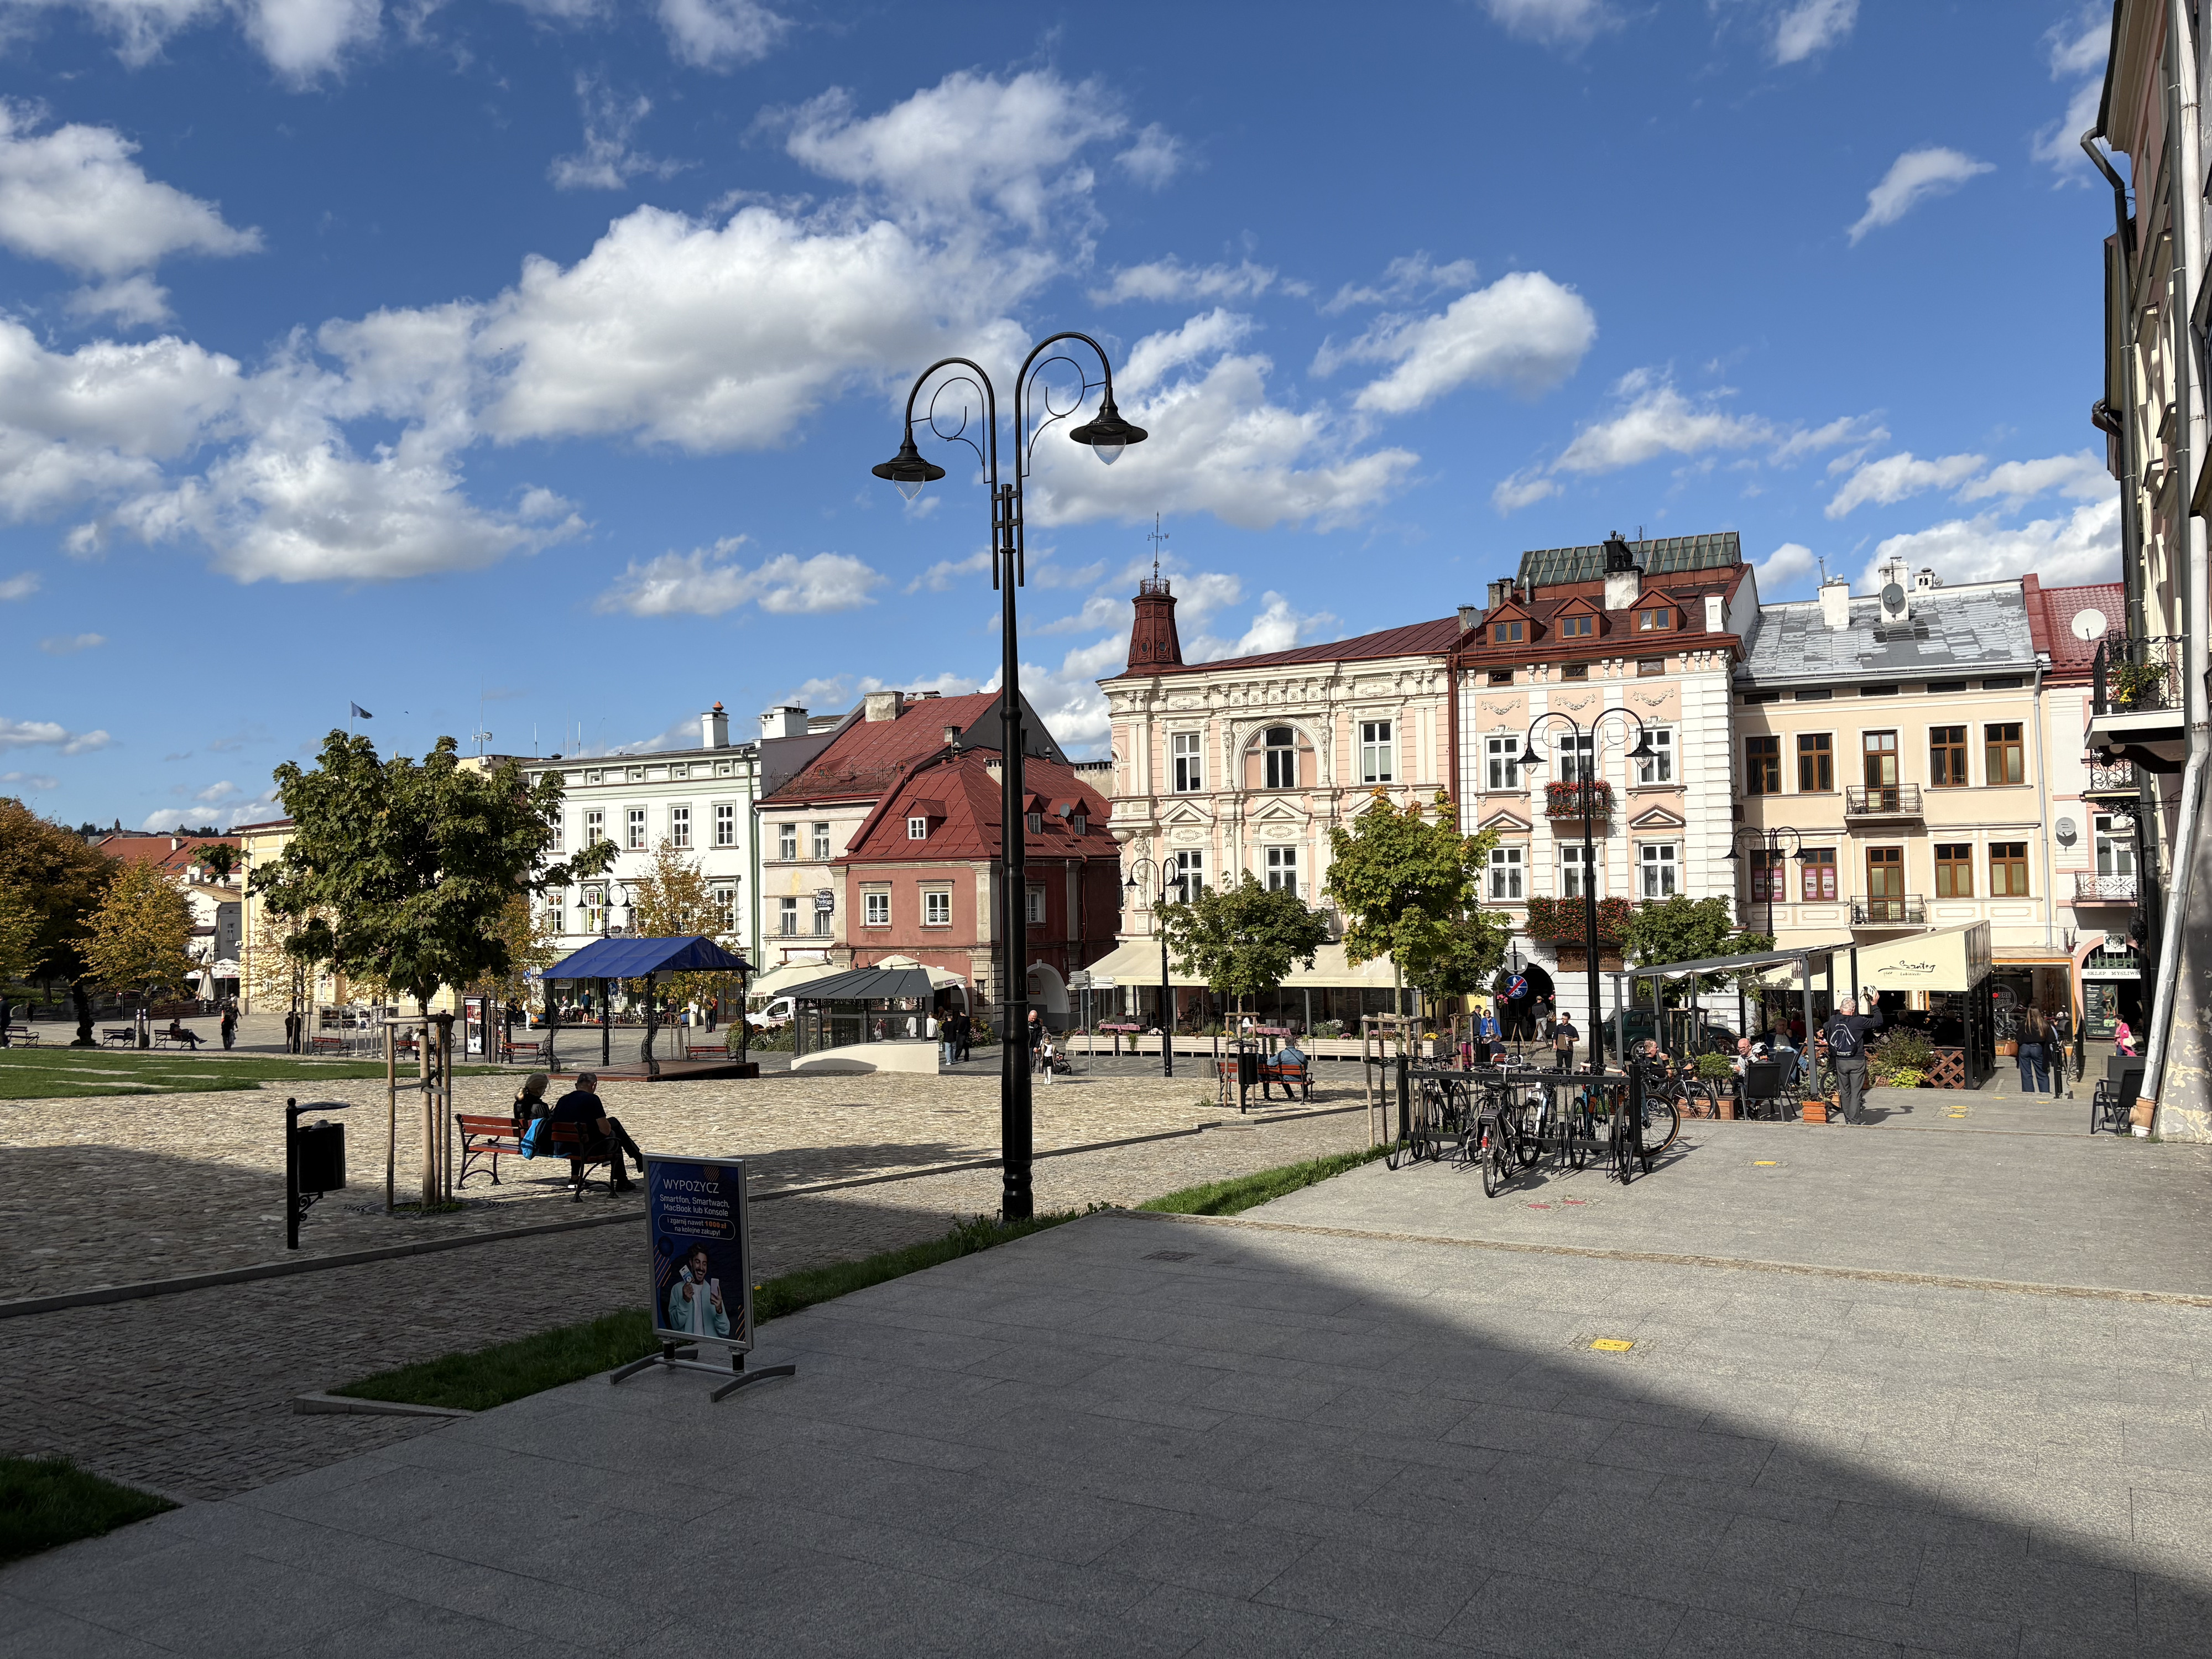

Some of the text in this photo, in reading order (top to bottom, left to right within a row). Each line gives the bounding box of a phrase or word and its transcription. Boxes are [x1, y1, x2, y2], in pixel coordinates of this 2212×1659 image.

[663, 1178, 719, 1193] WYPOŻYCZ
[660, 1194, 730, 1208] Smartfon, Smartwach,
[664, 1203, 692, 1213] MacBook
[705, 1207, 728, 1217] Konsole
